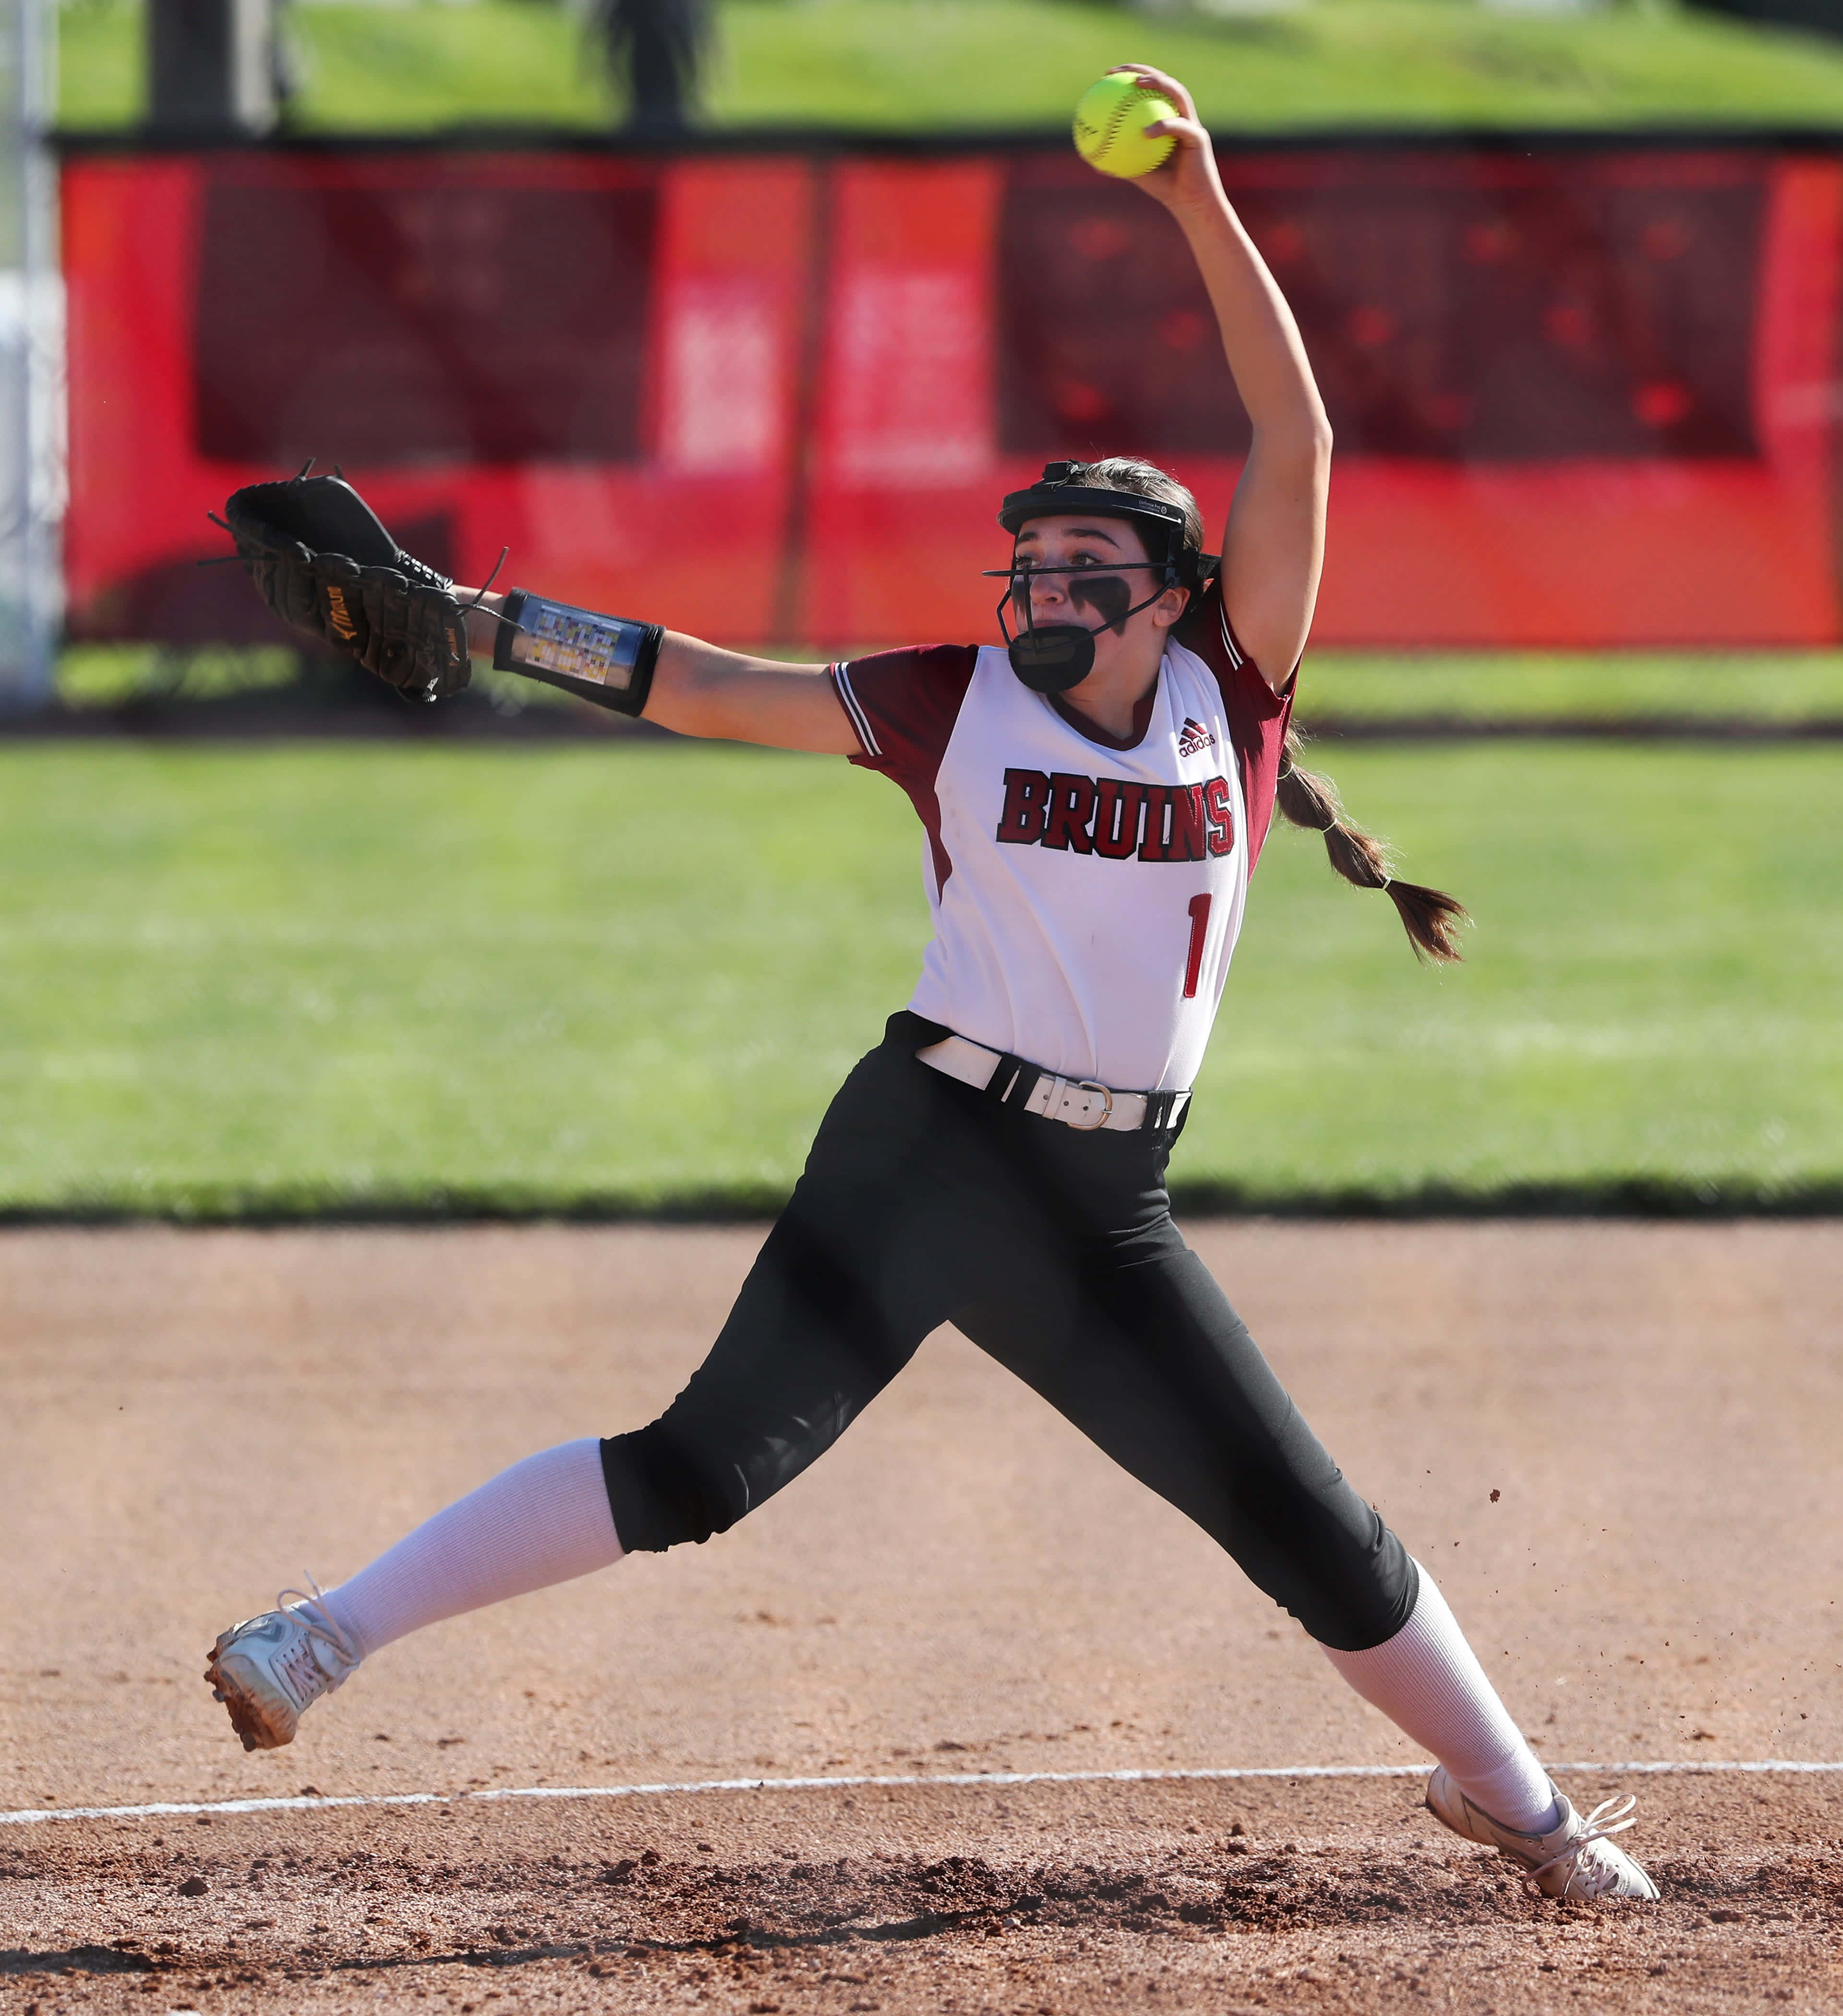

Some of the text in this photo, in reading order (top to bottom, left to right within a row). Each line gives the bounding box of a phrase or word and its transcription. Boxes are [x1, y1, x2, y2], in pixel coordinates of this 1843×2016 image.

[1179, 734, 1216, 757] adidas
[996, 768, 1234, 862] BRUINS
[1183, 893, 1212, 998] 1
